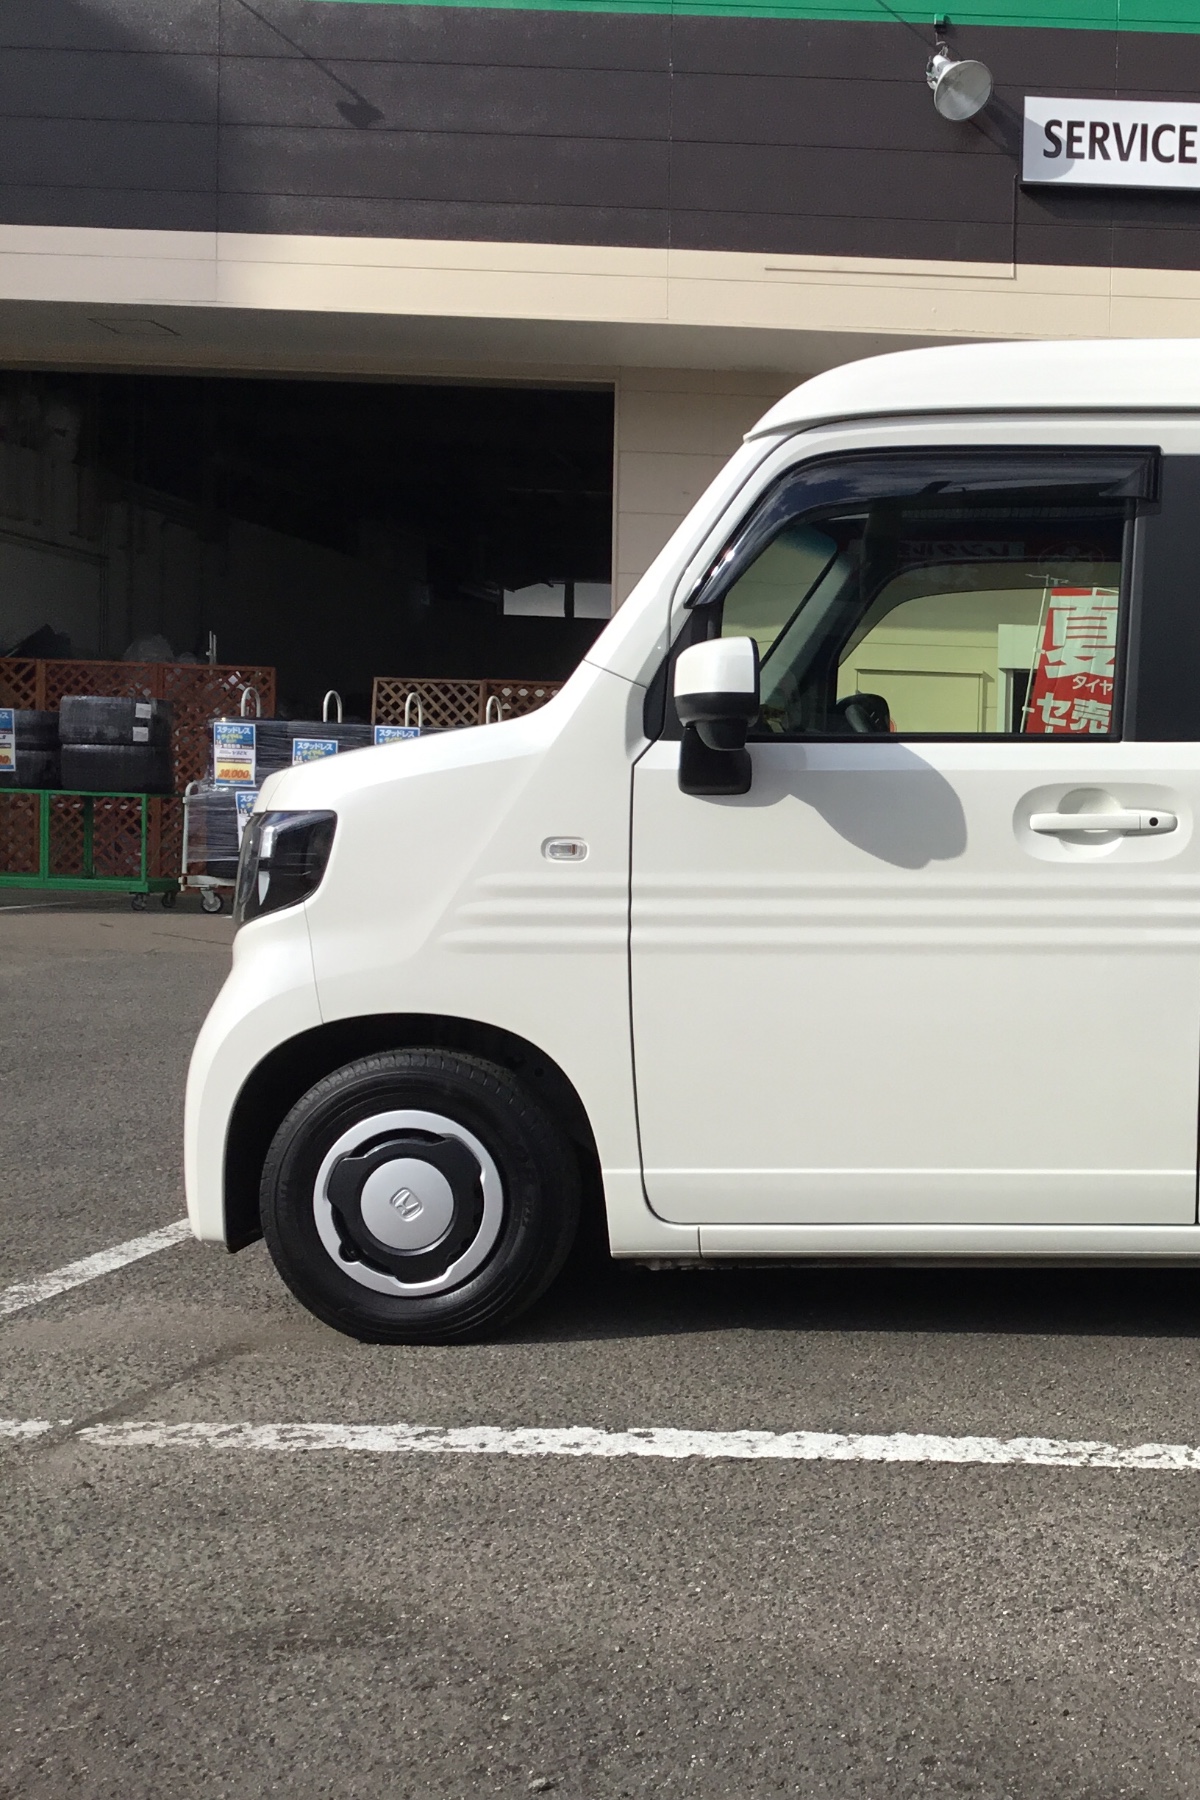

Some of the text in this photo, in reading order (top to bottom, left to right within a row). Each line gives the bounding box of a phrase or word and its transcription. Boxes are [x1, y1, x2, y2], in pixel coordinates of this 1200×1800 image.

[1043, 119, 1198, 164] SERVICE
[1044, 594, 1119, 679] 夏
[1072, 675, 1113, 696] タイヤ
[1036, 691, 1072, 733] セ
[297, 742, 333, 751] スタッドレス
[379, 729, 415, 738] スタッドレス
